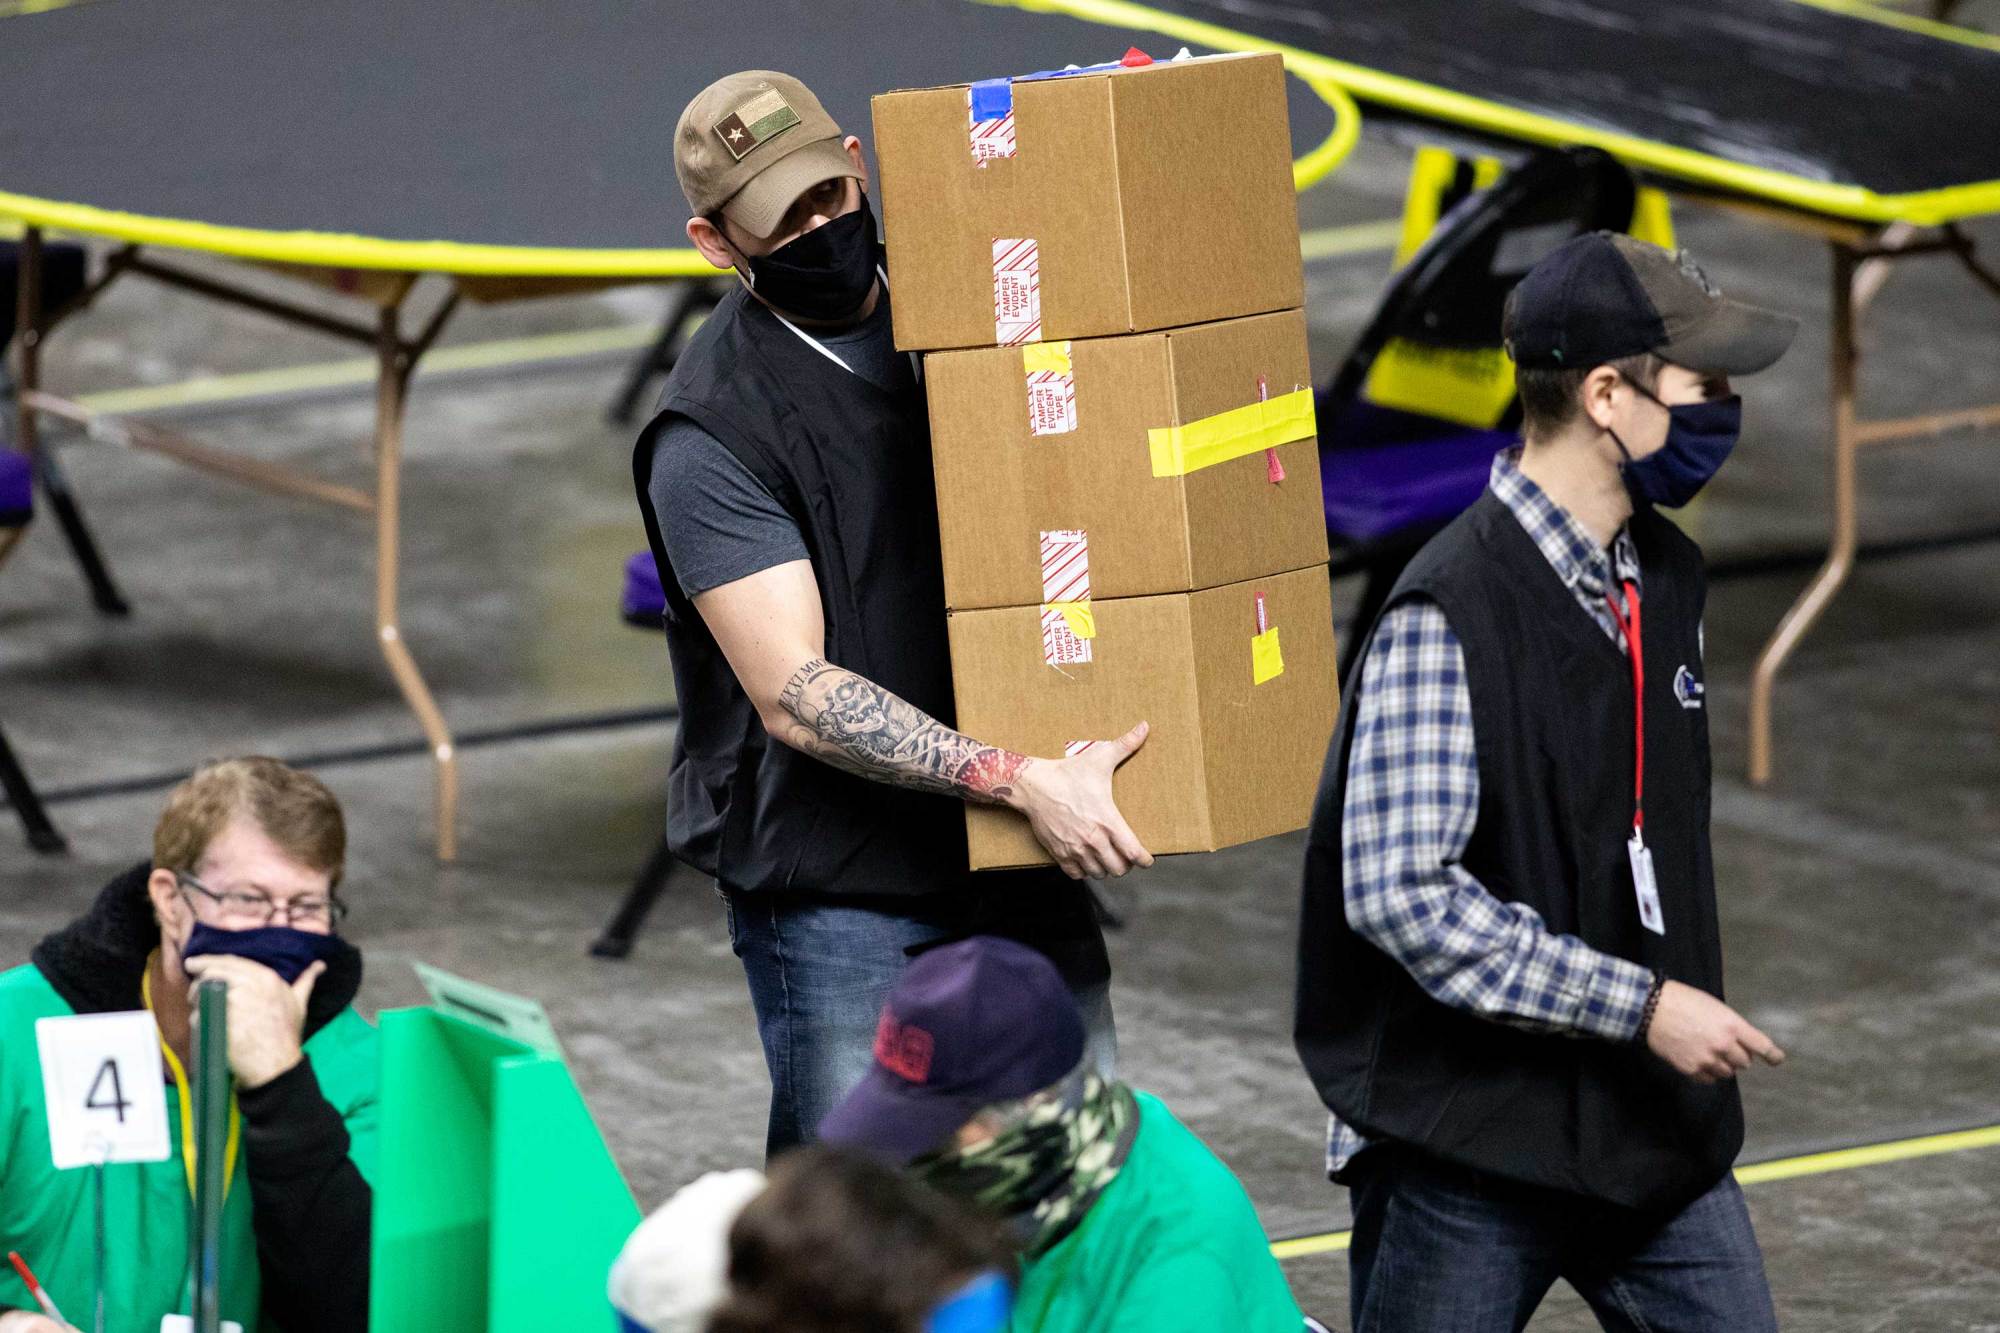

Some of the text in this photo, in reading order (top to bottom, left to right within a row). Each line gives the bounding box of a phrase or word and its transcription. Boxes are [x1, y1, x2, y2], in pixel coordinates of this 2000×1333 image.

[1002, 277, 1010, 317] TAMPER
[1011, 276, 1019, 317] EVIDENT
[1020, 284, 1028, 309] TAPE
[1036, 389, 1046, 429] TAMPER
[1045, 388, 1056, 428] EVIDENT
[1055, 395, 1064, 420] TAPE
[85, 1057, 132, 1123] 4
